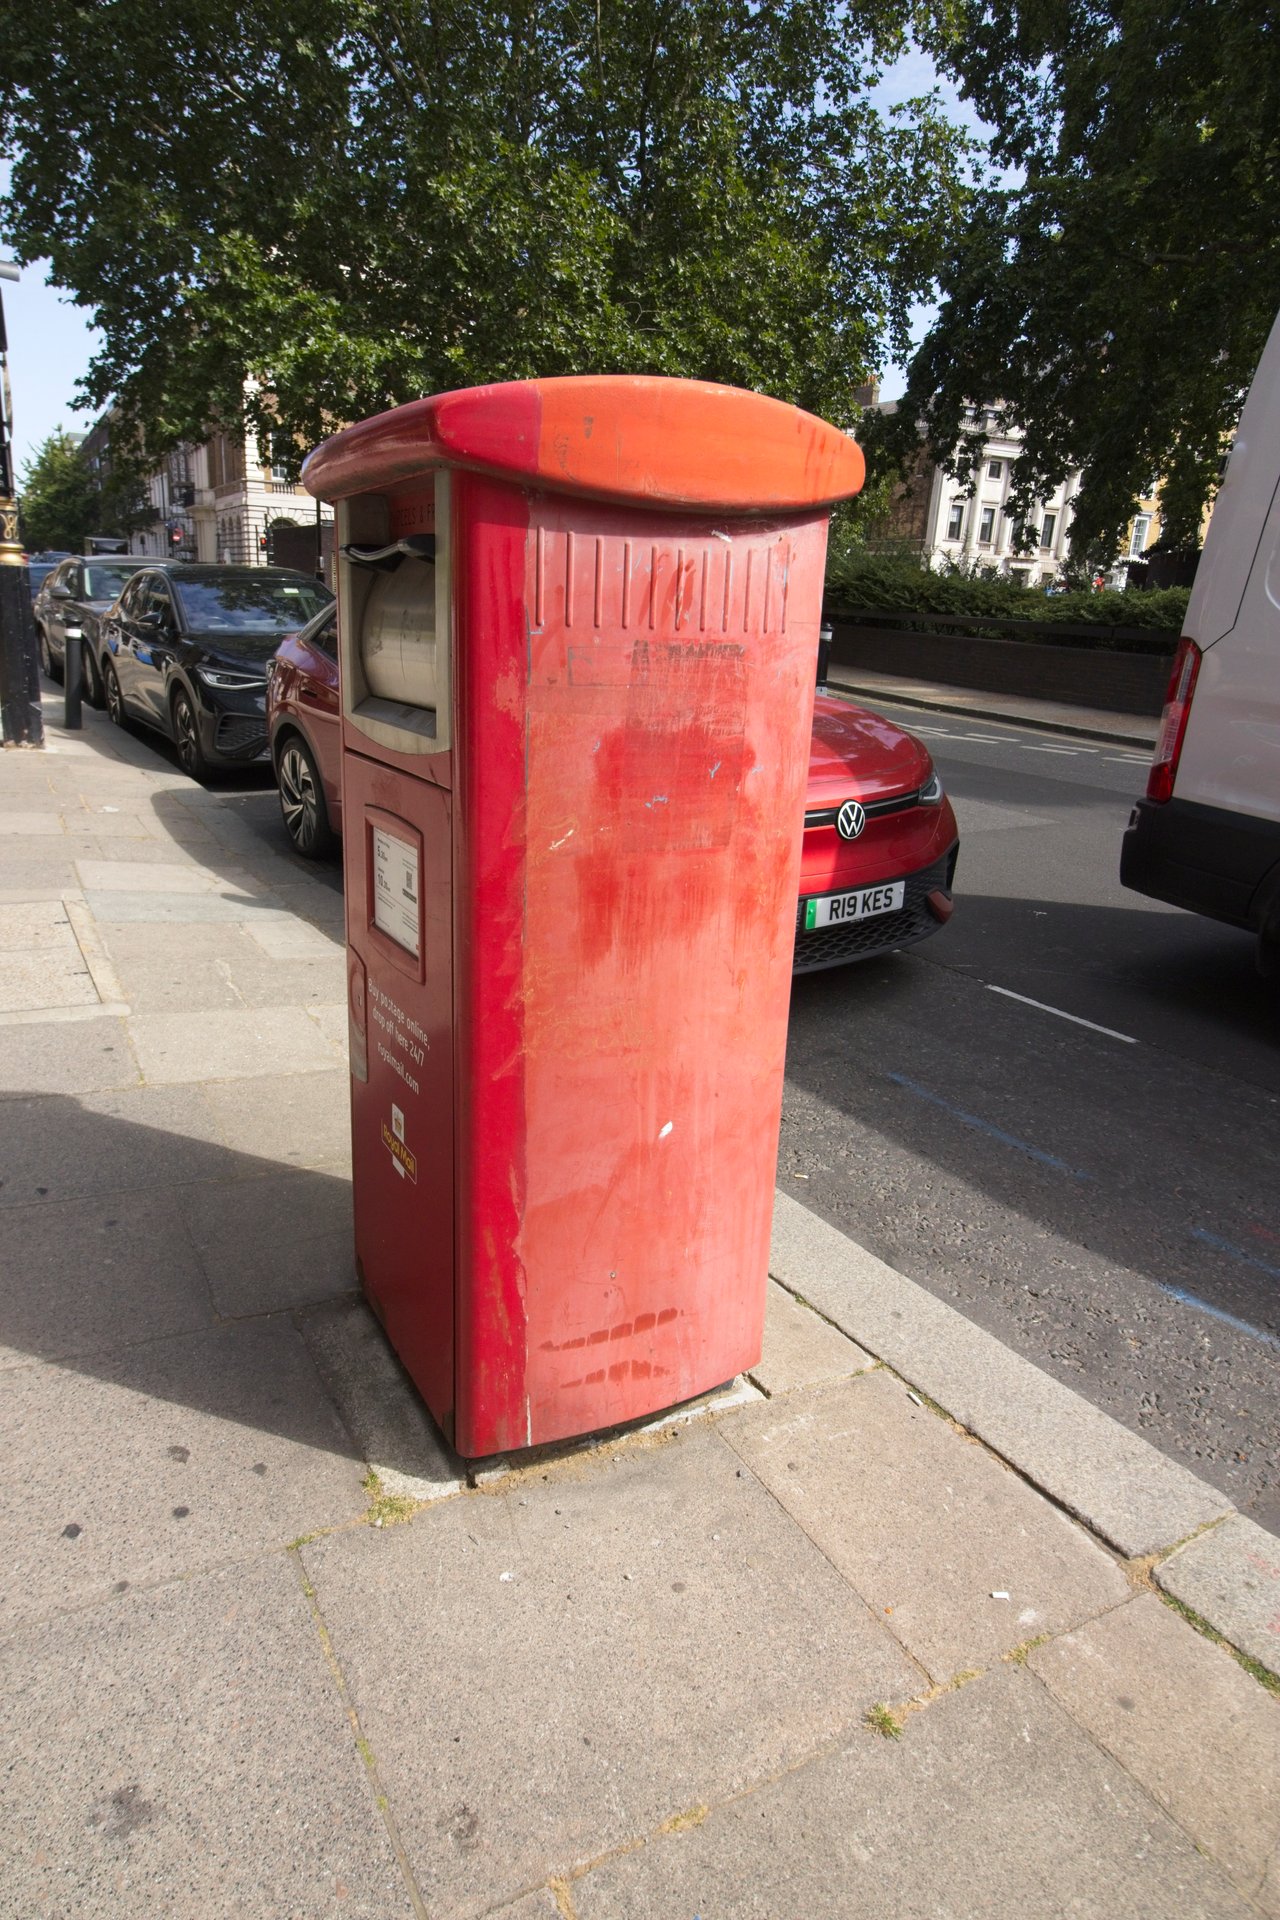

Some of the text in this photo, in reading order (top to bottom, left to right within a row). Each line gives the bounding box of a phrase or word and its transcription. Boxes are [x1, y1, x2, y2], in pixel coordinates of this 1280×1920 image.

[829, 887, 894, 921] R19 KES
[368, 977, 430, 1051] Buy postage online,
[372, 1005, 425, 1067] drop off here 24/7
[378, 1041, 419, 1095] royalmail.com
[383, 1122, 415, 1175] Royal Mail
